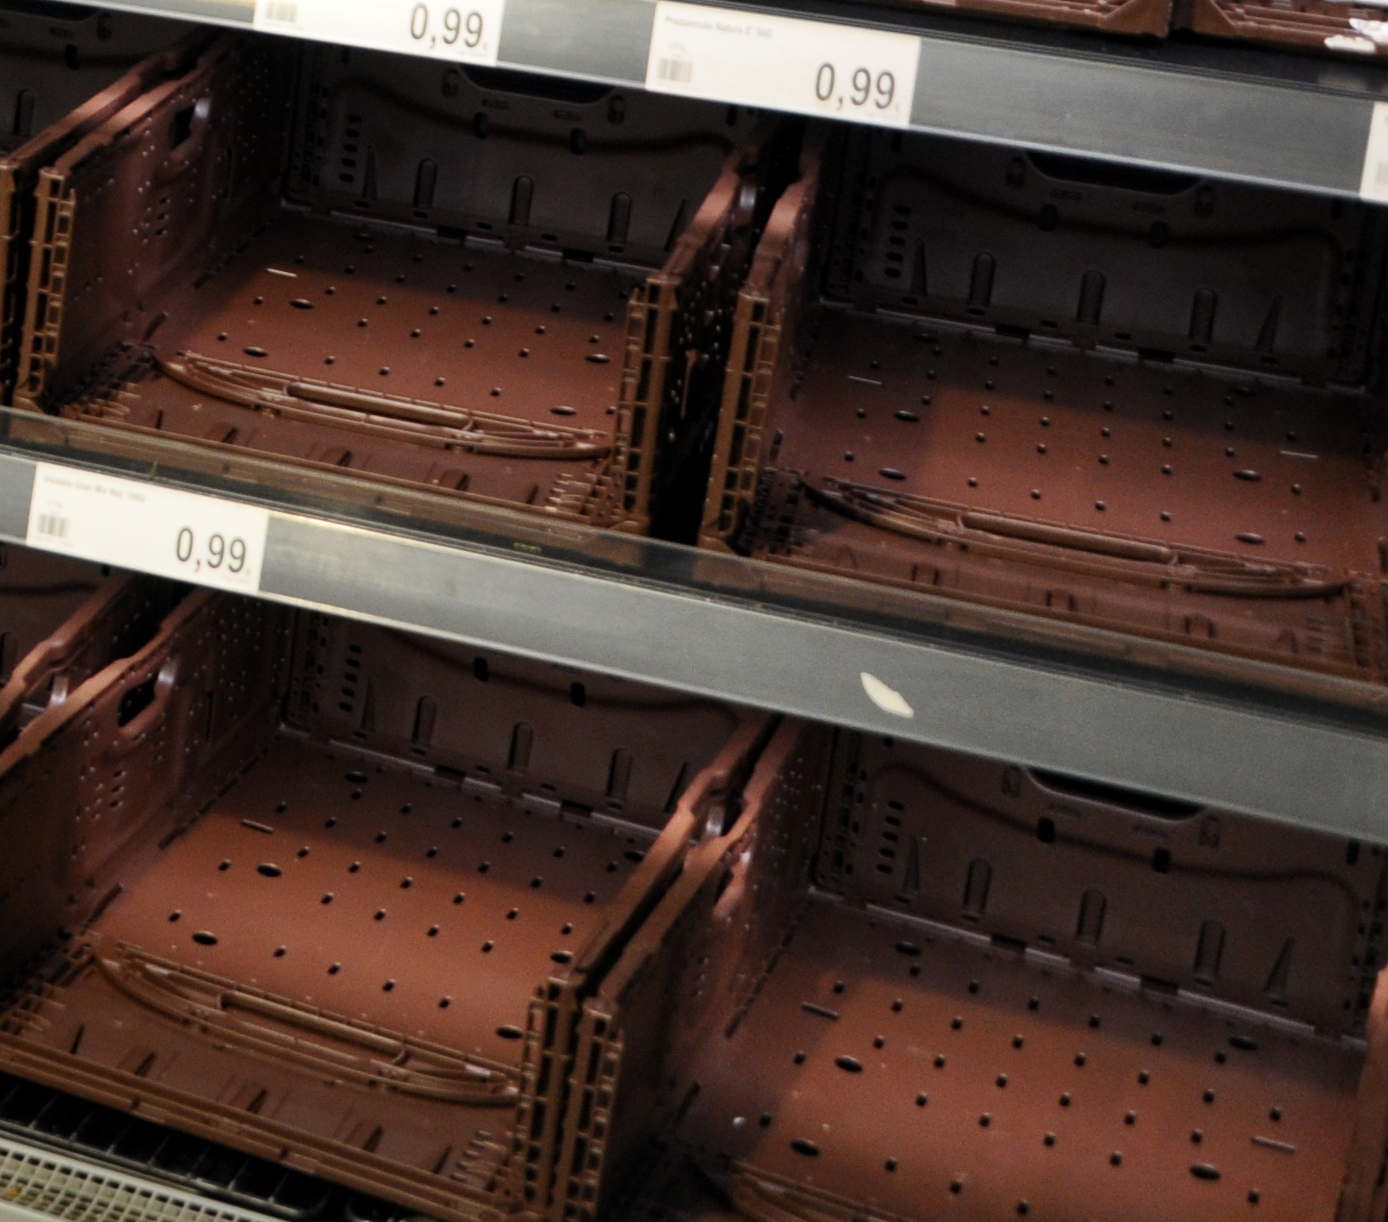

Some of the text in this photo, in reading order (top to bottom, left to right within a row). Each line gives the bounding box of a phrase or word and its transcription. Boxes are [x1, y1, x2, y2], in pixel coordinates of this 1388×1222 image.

[409, 1, 484, 50] 0,99
[814, 60, 896, 111] 0,99
[175, 525, 247, 574] 0,99
